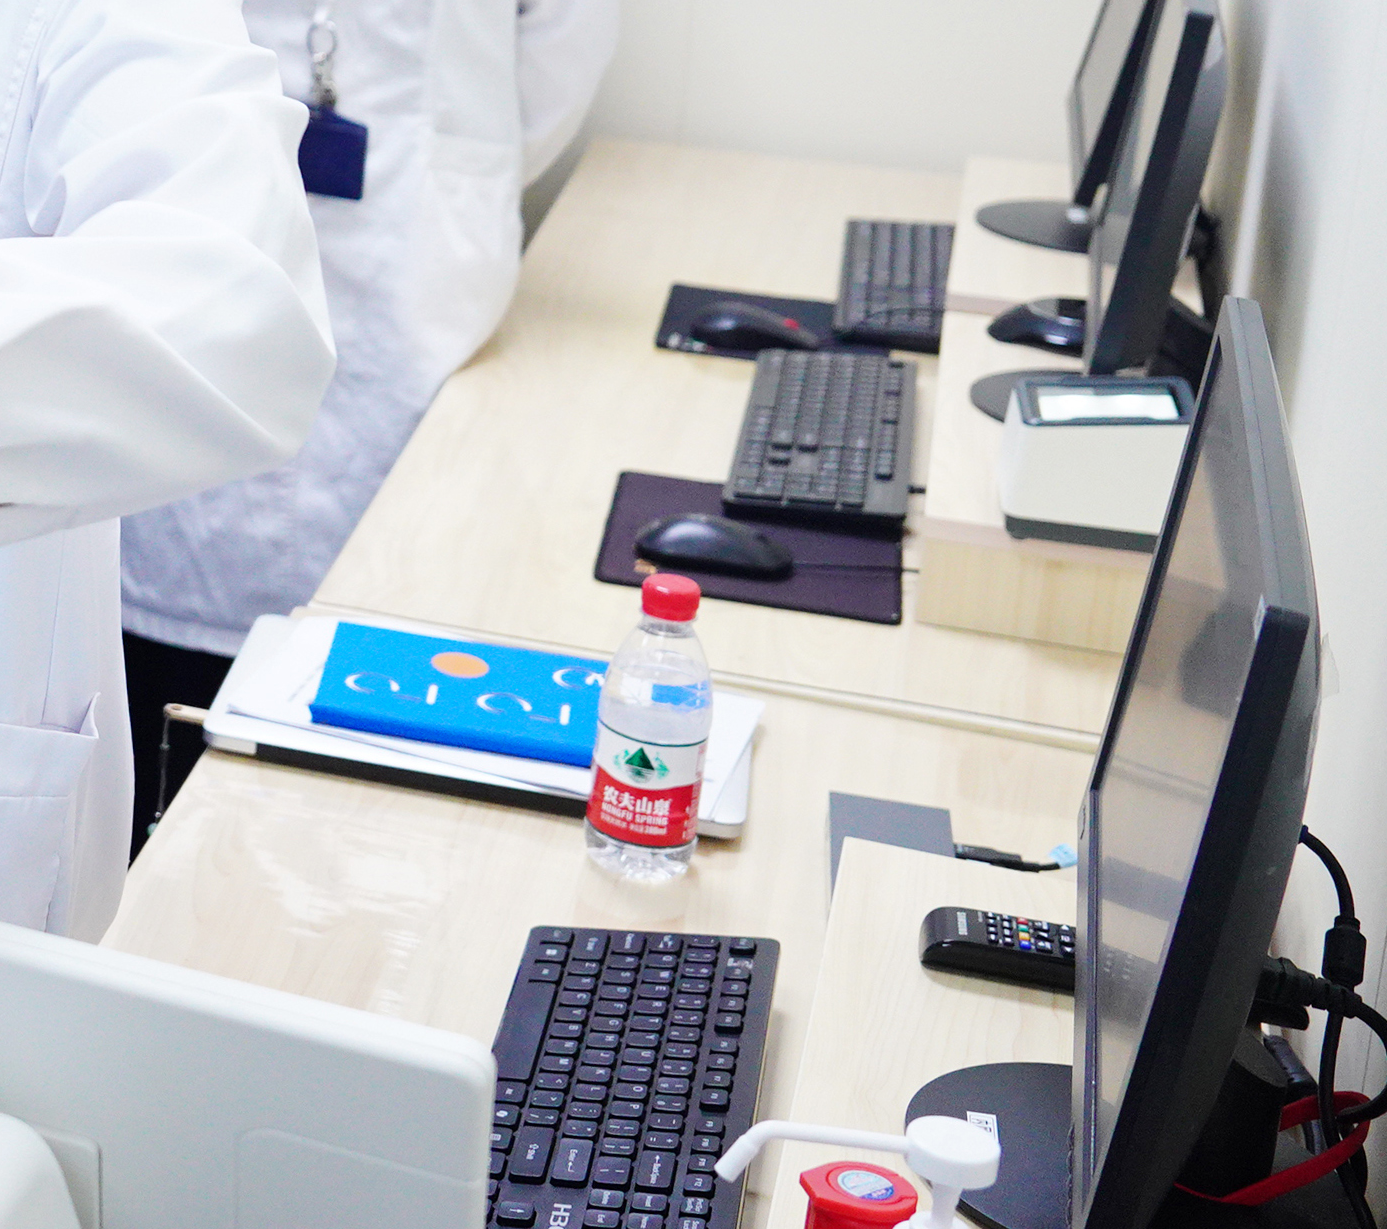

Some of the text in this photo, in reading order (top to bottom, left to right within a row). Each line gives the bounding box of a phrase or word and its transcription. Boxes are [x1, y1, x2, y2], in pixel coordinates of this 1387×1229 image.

[603, 785, 671, 816] 农夫山泉
[602, 802, 633, 822] NONGFU
[635, 814, 669, 827] SPRING
[548, 1203, 573, 1229] H3
